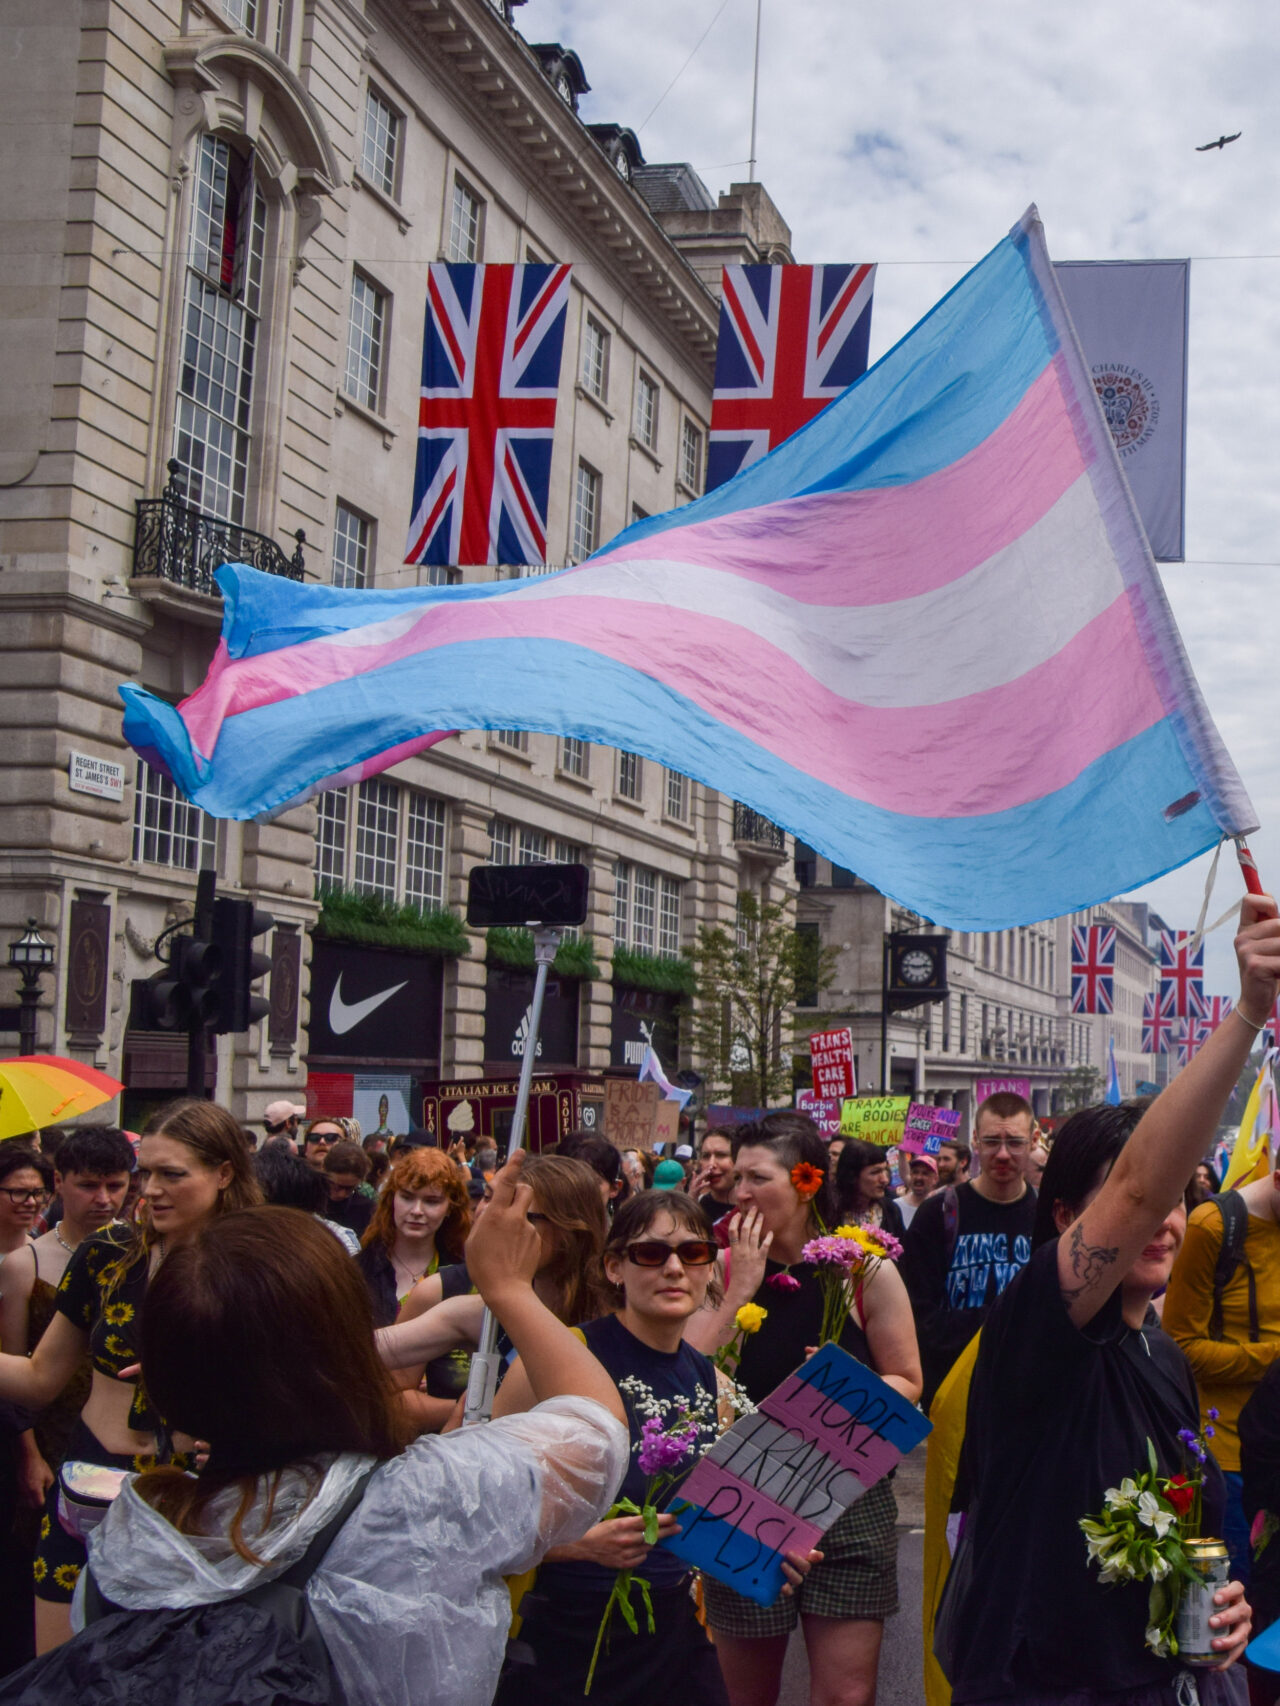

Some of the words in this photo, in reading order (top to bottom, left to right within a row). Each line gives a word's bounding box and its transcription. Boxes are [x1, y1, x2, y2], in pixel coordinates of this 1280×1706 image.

[1091, 363, 1144, 380] CHARLES
[75, 756, 98, 771] REGENT
[99, 762, 120, 777] STREET
[512, 1040, 542, 1056] ads
[811, 1031, 849, 1051] TRANS
[624, 1041, 648, 1064] PUM
[811, 1047, 852, 1067] HEALTH
[818, 1065, 845, 1082] CARE
[445, 1085, 489, 1096] ITALIAN
[493, 1083, 509, 1094] ICE
[512, 1081, 551, 1093] CAM
[608, 1081, 654, 1103] PRIDE
[821, 1081, 846, 1098] NOW
[981, 1082, 1024, 1095] TRANS
[801, 1100, 834, 1110] Barbie
[848, 1098, 896, 1111] TRANS
[863, 1110, 907, 1122] BODIES
[841, 1121, 861, 1132] ARE
[859, 1128, 900, 1144] RADICAL
[952, 1233, 1008, 1268] KING
[1014, 1234, 1031, 1264] O
[994, 1262, 1022, 1296] YO
[784, 1361, 907, 1458] MORE
[720, 1408, 860, 1519] TRANS
[681, 1485, 796, 1585] PLS!
